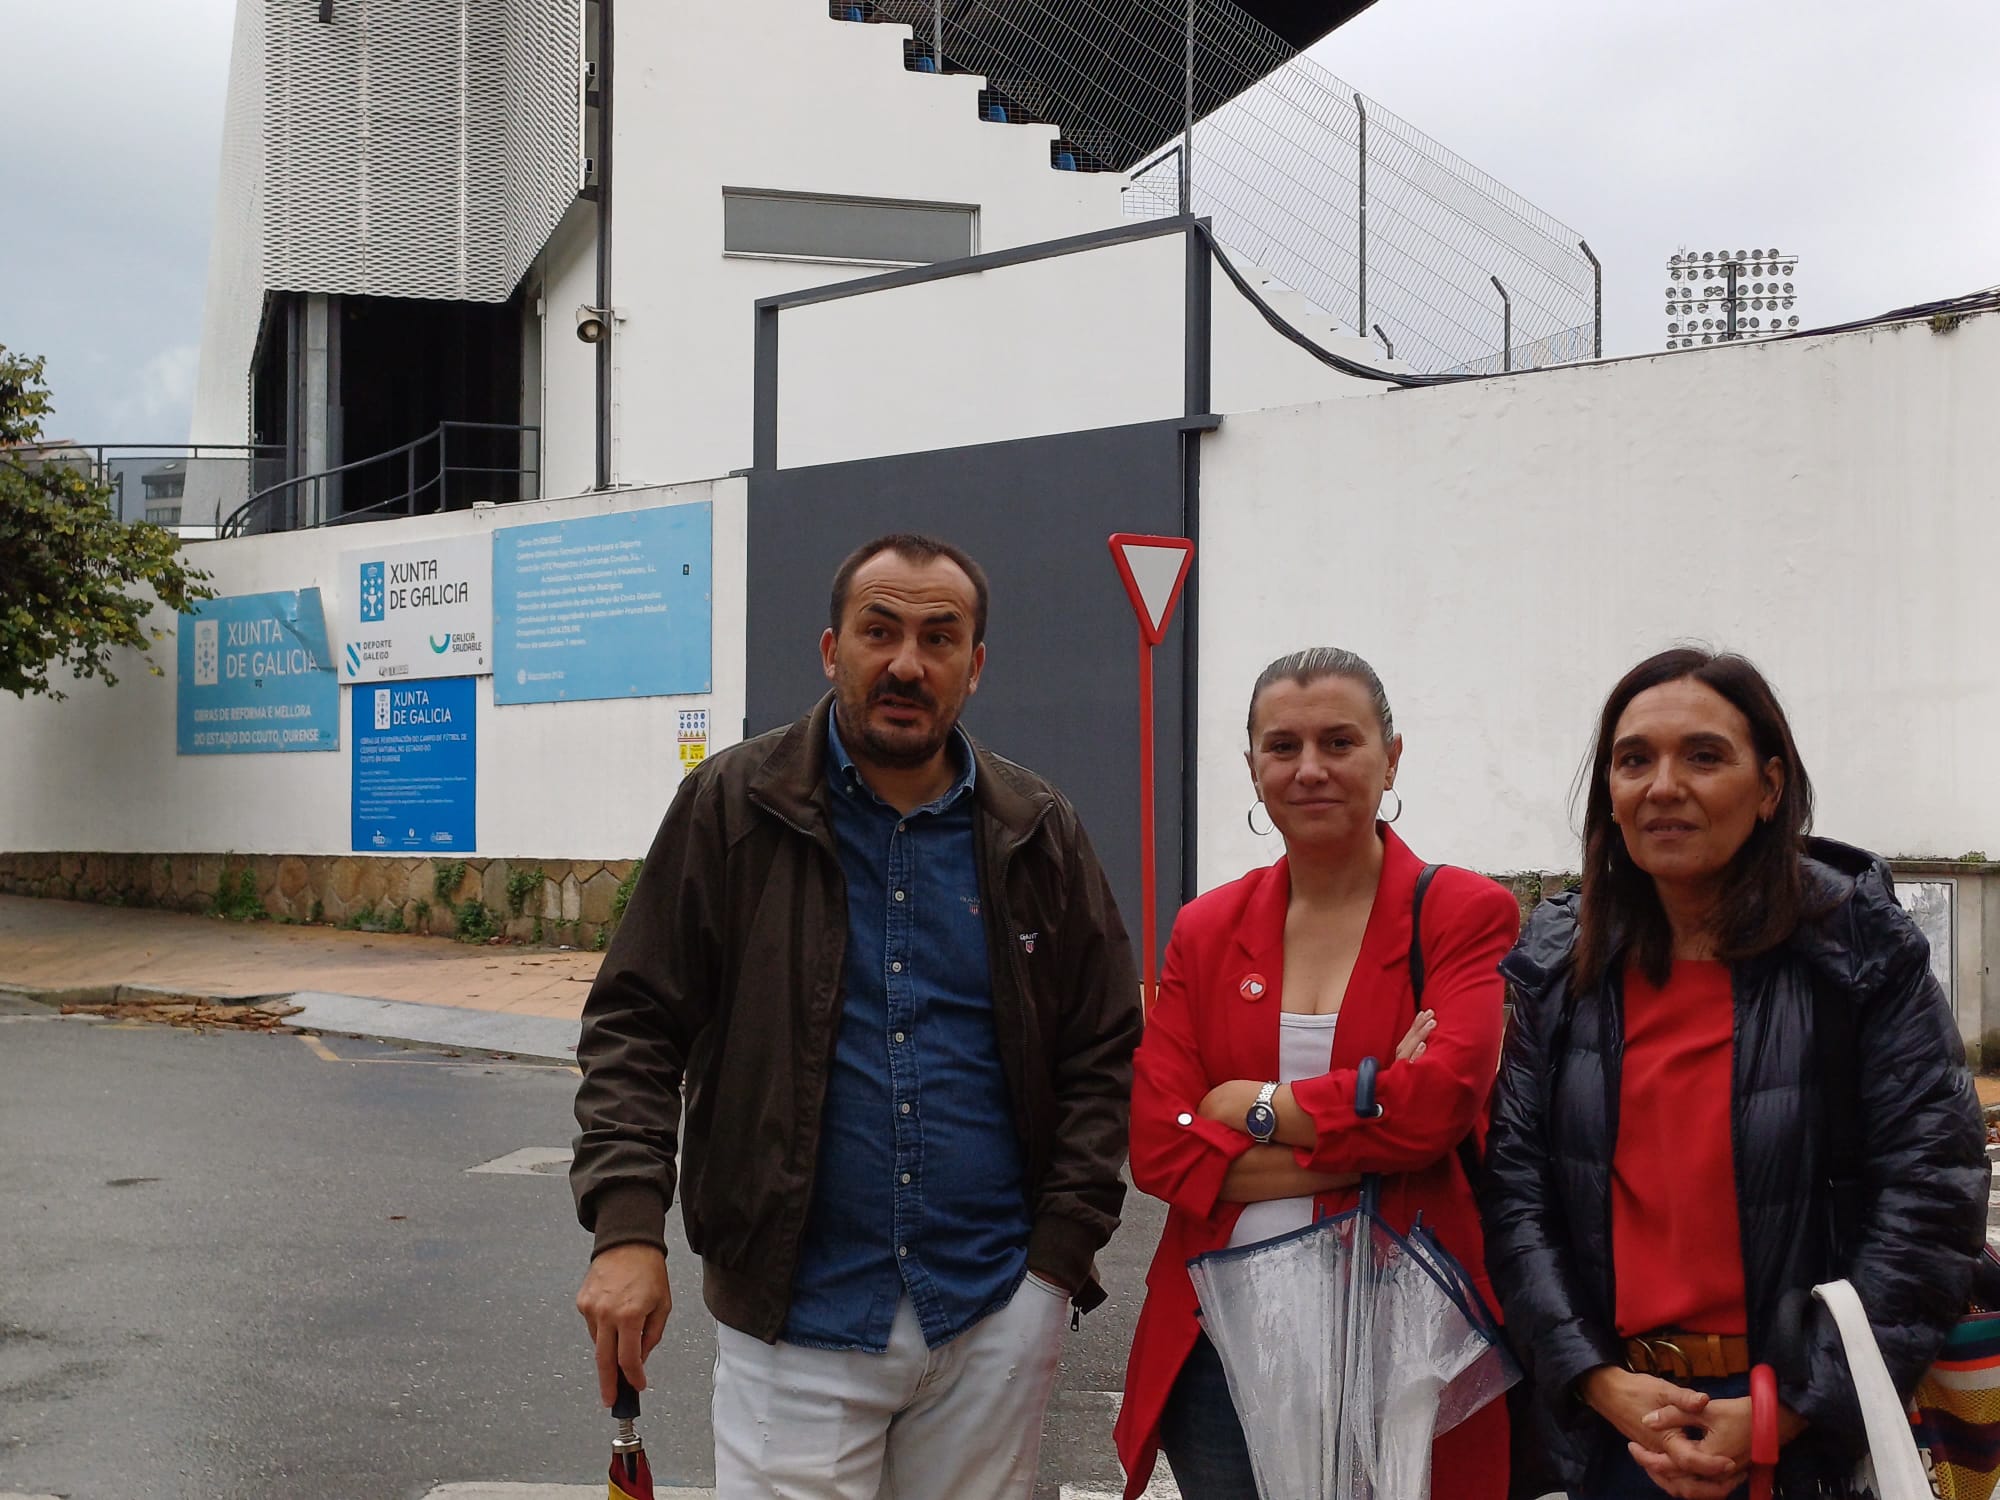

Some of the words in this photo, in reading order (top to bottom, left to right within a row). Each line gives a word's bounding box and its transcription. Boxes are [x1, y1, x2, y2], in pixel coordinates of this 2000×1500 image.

[390, 559, 438, 585] XUNTA
[390, 589, 407, 610] DE
[410, 582, 468, 607] GALICIA
[227, 619, 283, 646] XUNTA
[452, 632, 475, 643] GALICIA
[363, 640, 392, 650] DEPORTE
[452, 642, 482, 653] SAUDABLE
[226, 653, 248, 678] DE
[252, 650, 320, 677] GALICIA
[363, 651, 389, 661] GALEGO
[394, 690, 429, 707] XUNTA
[219, 708, 229, 721] DE
[231, 706, 267, 720] REFORMA
[274, 704, 312, 719] MELLORA
[393, 710, 407, 725] DE
[409, 707, 452, 724] GALICIA
[282, 728, 319, 742] OURENSE
